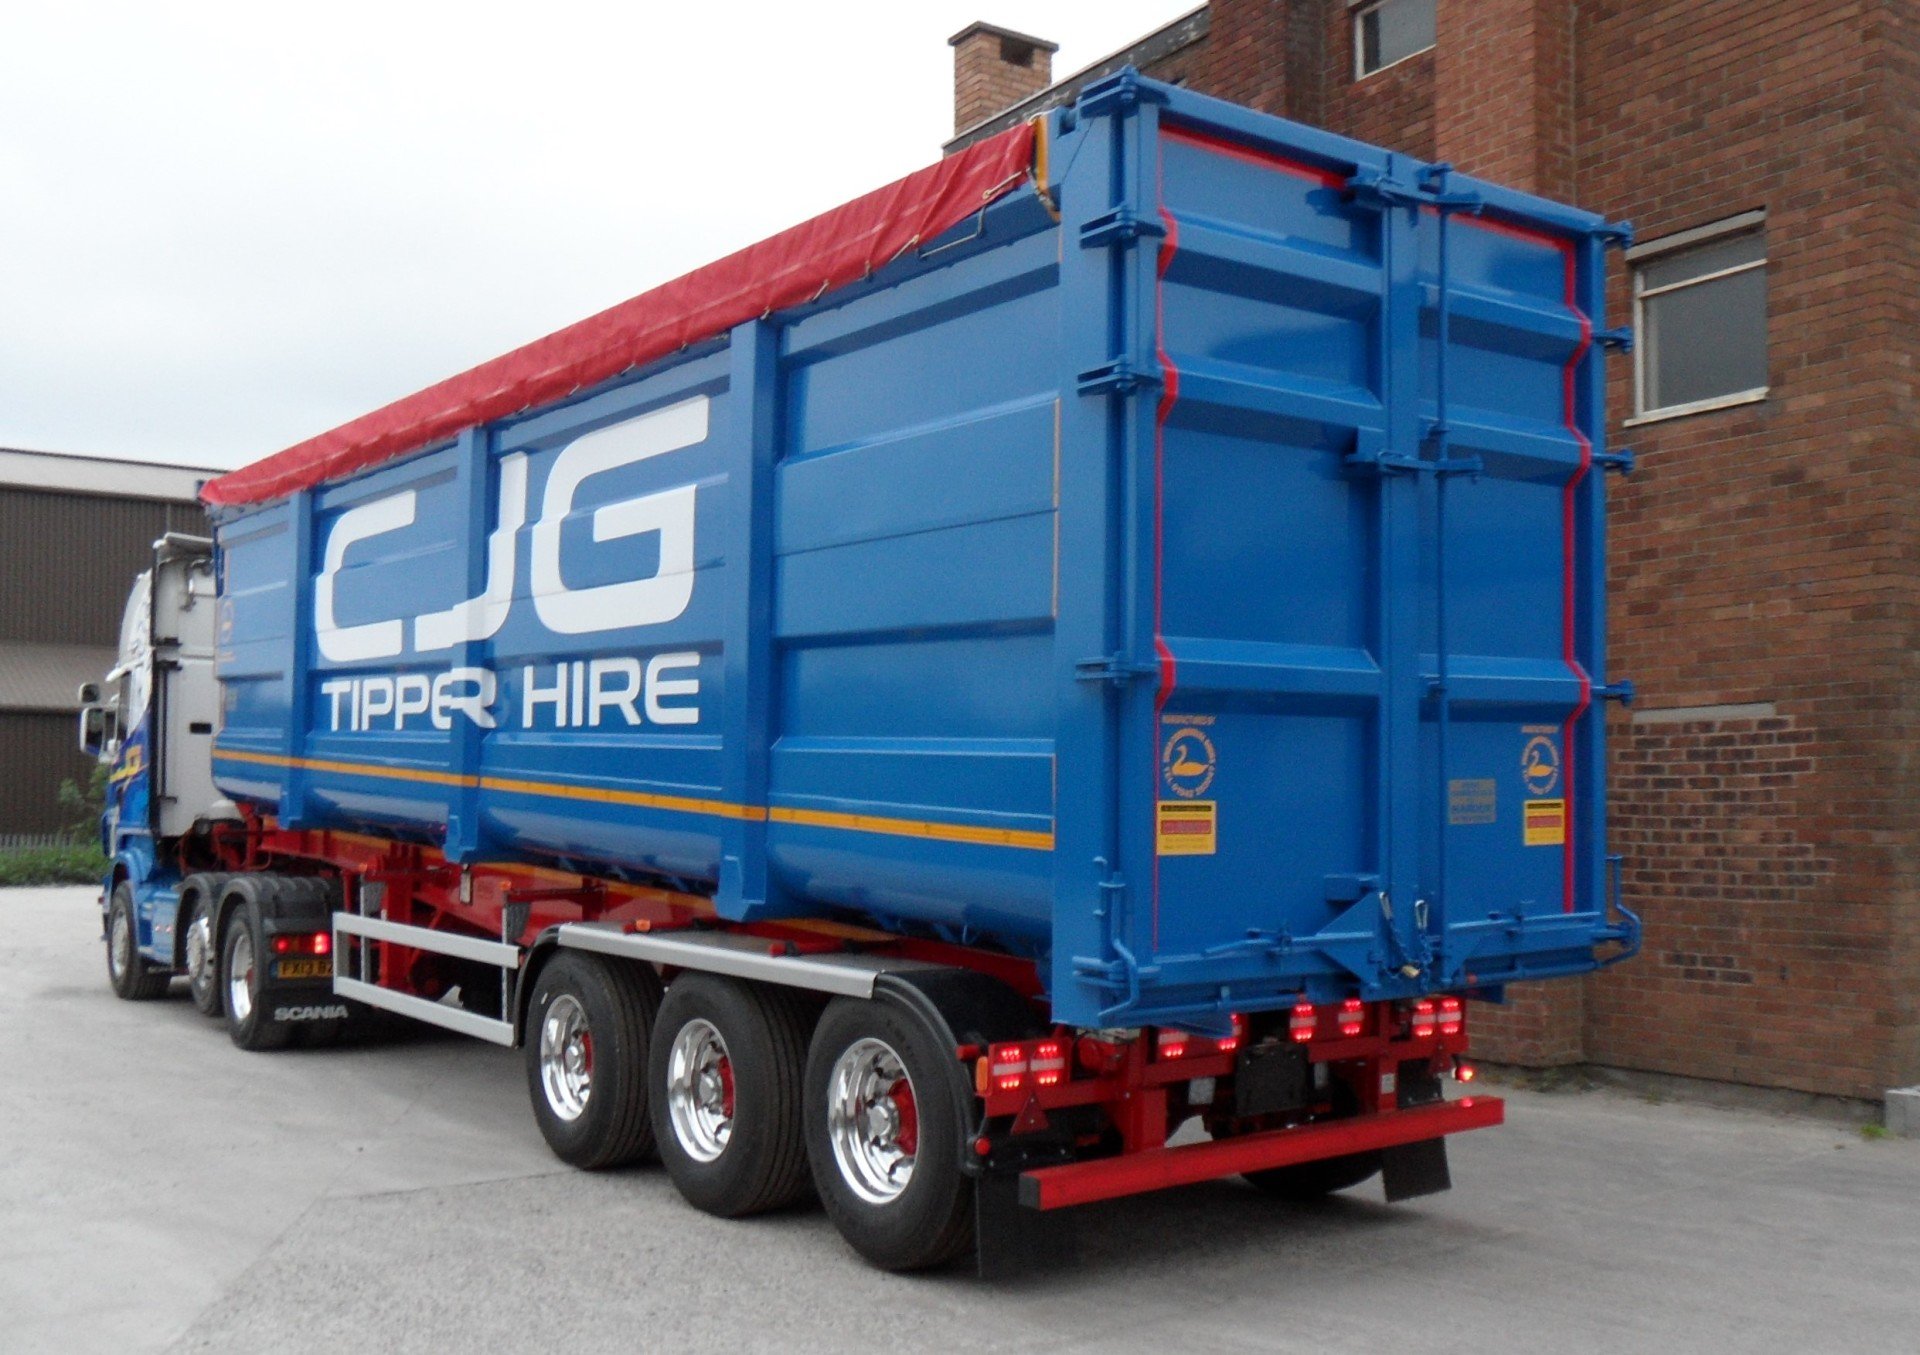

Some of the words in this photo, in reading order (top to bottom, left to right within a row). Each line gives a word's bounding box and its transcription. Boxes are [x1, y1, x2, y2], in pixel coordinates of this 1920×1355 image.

[314, 394, 710, 662] CJG
[321, 667, 498, 732] TIPPER
[522, 652, 701, 729] HIRE
[274, 1004, 349, 1021] SCANIA
